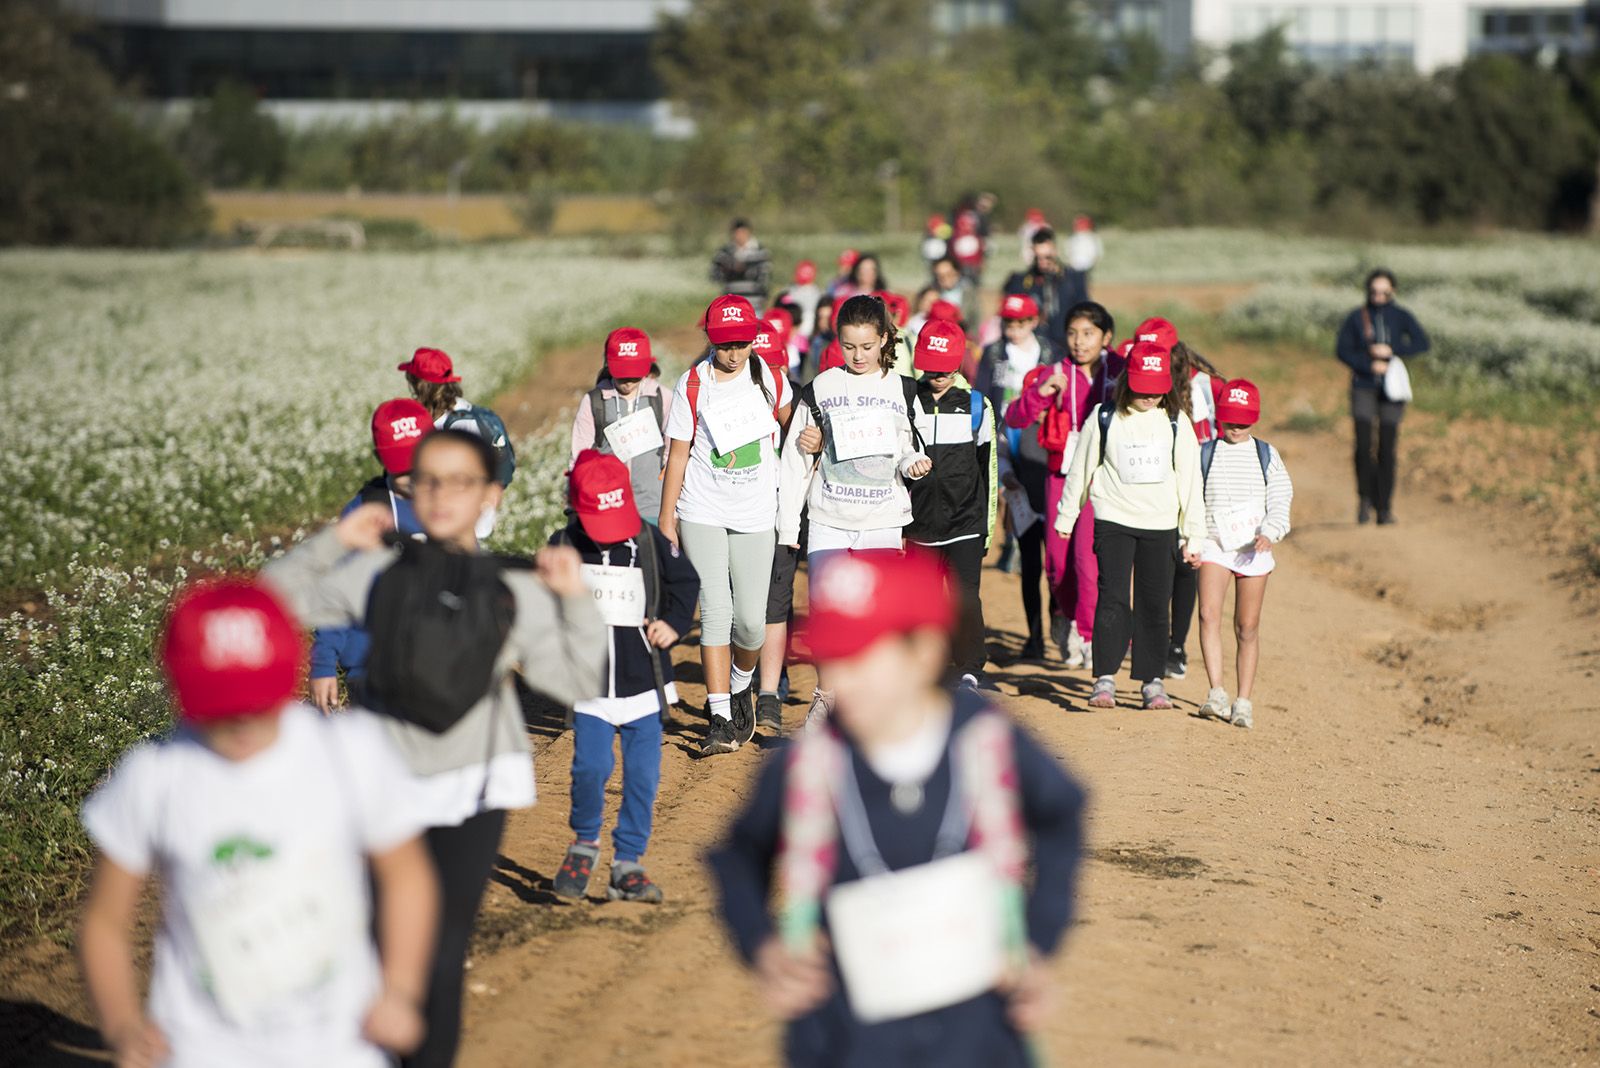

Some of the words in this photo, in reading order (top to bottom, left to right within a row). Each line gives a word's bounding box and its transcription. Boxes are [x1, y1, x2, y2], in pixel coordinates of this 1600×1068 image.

[722, 307, 742, 317] TOT
[619, 342, 638, 353] TOT
[929, 336, 949, 348] TOT
[1142, 356, 1161, 367] TOT
[1230, 388, 1249, 400] TOT
[391, 416, 417, 433] TOT
[1129, 456, 1160, 467] 0148
[597, 488, 624, 504] TOT
[594, 588, 636, 602] 0145
